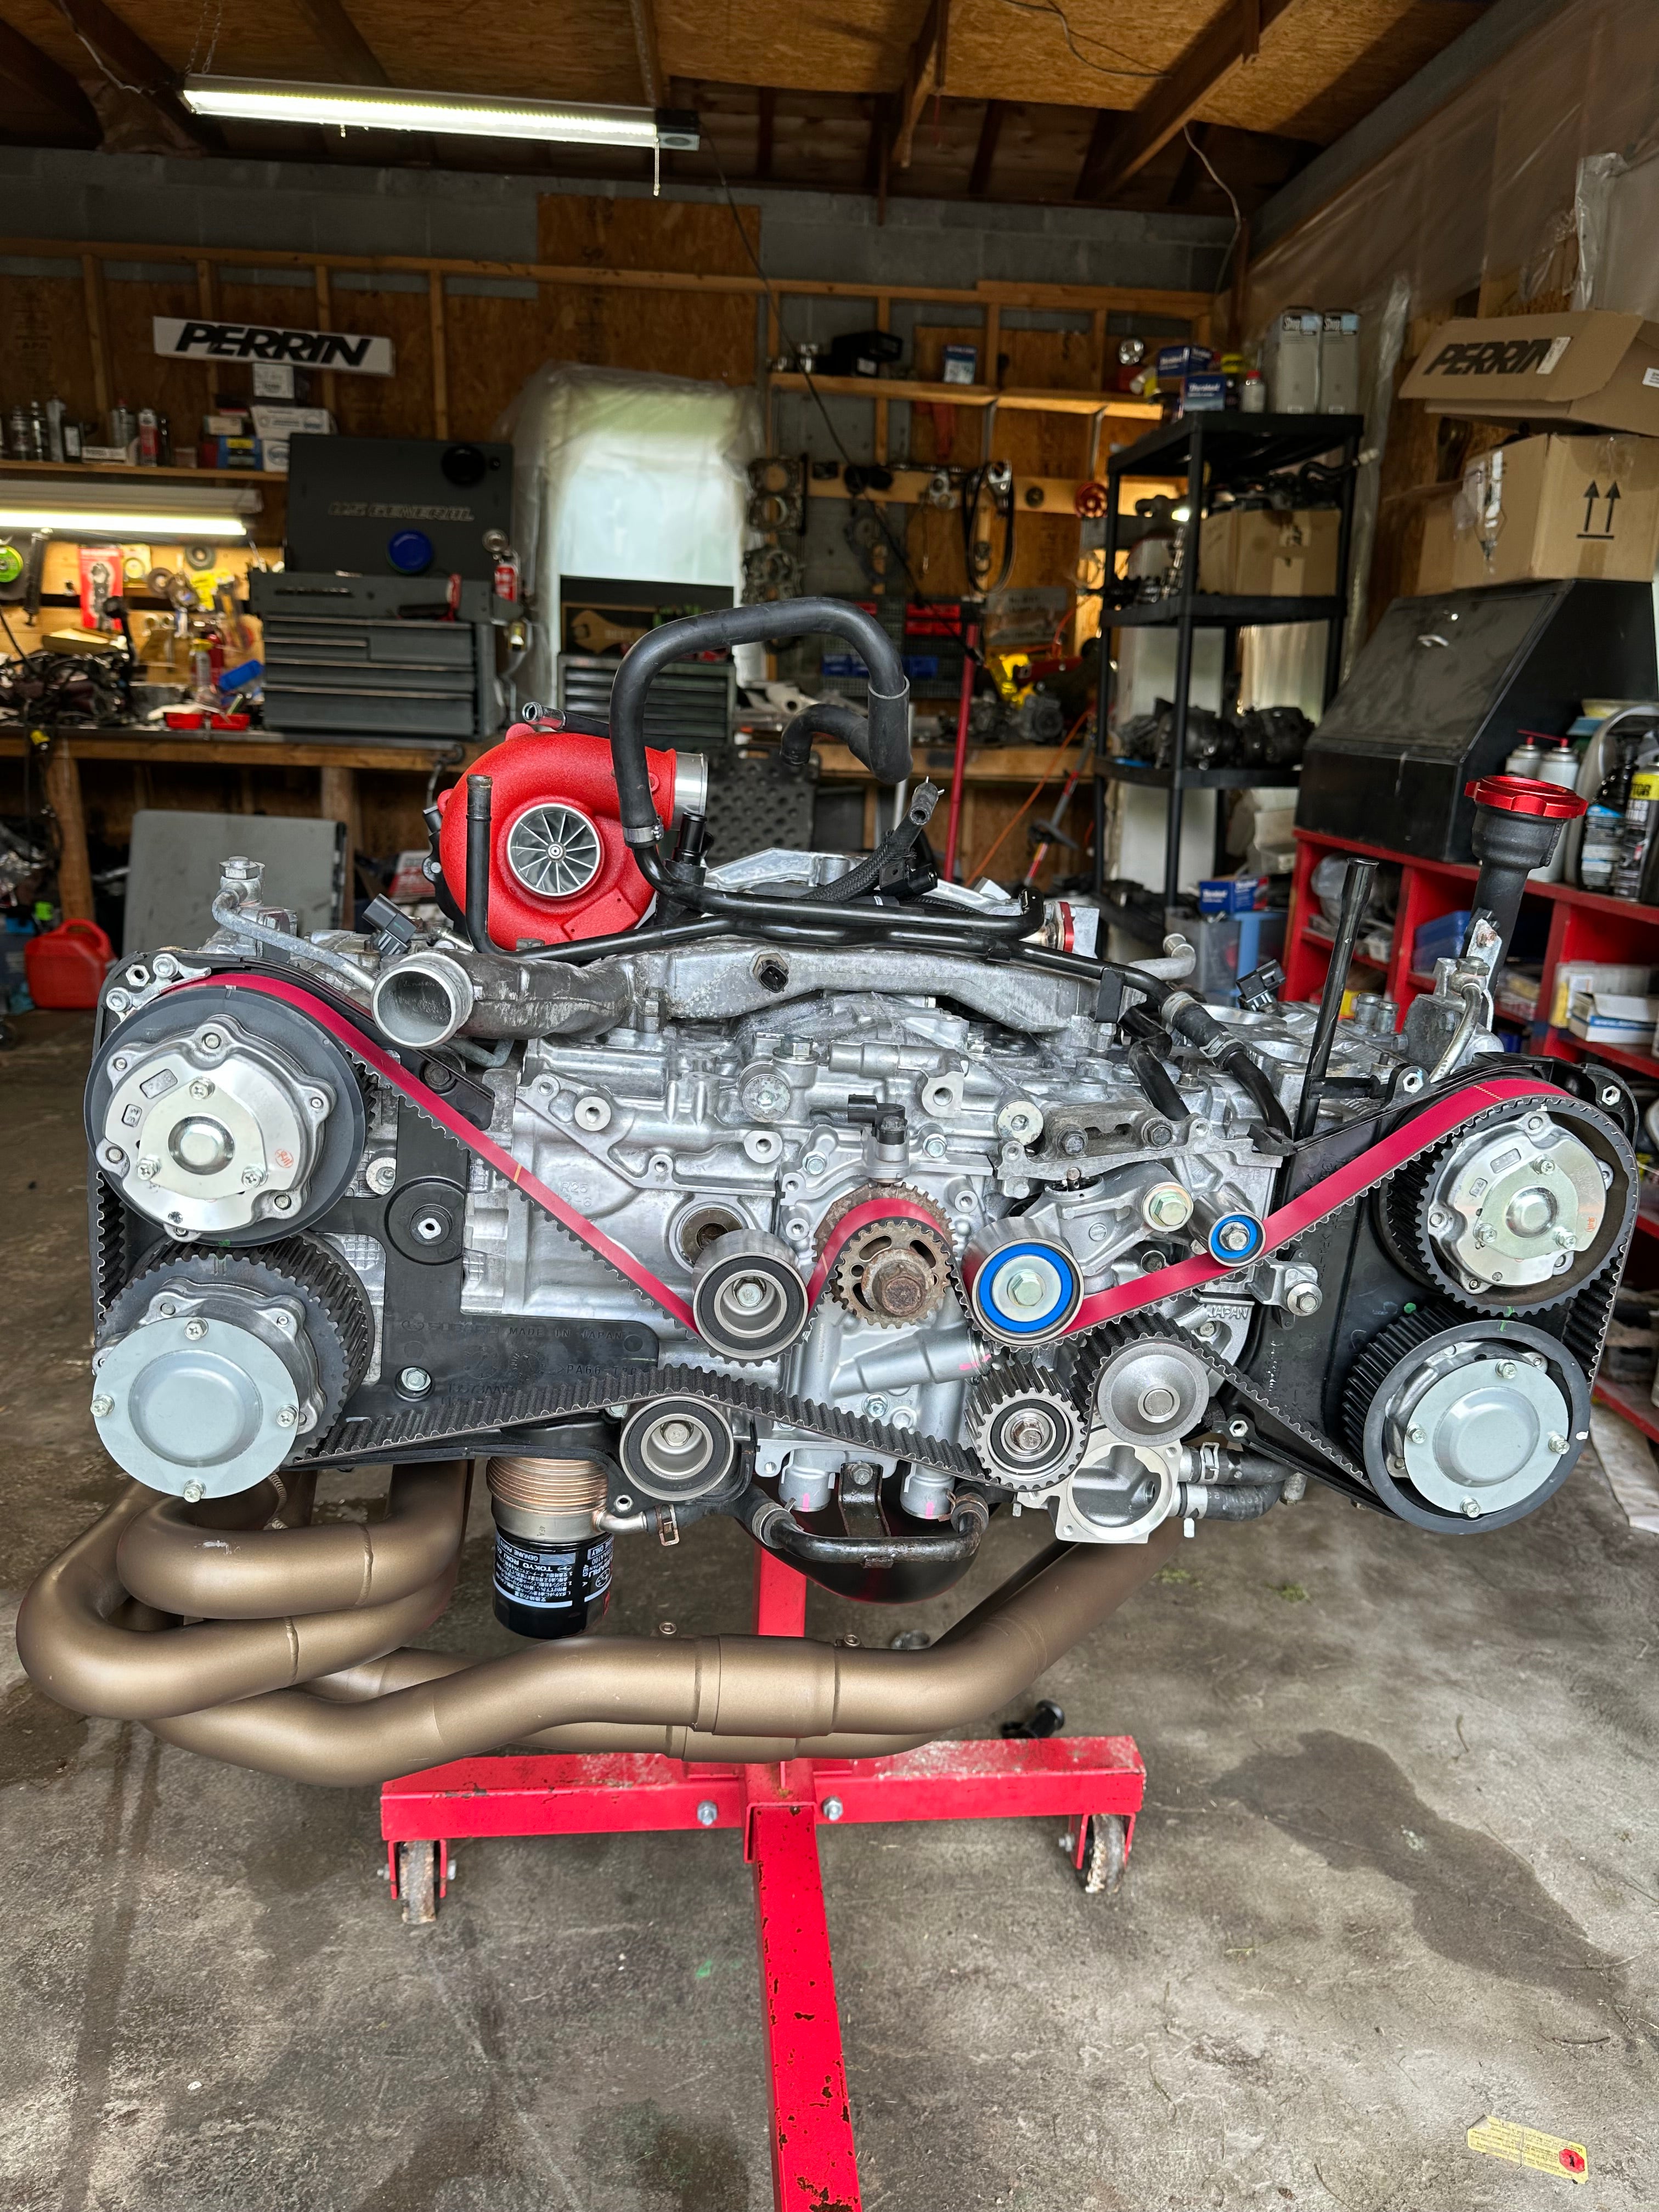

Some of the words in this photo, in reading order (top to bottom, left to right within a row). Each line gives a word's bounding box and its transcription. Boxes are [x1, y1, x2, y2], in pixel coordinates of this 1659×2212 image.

[176, 321, 373, 367] PERRIN
[1207, 1305, 1249, 1320] JAPAN
[509, 1327, 544, 1337] MADE
[555, 1329, 571, 1338] IN
[581, 1330, 623, 1340] JAPAN
[500, 1539, 512, 1553] PARTS
[591, 1544, 604, 1556] ONLY
[504, 1553, 520, 1565] ROKI
[514, 1549, 538, 1561] GENUINE
[523, 1563, 553, 1572] TOKYO
[589, 1561, 603, 1571] JAPAN
